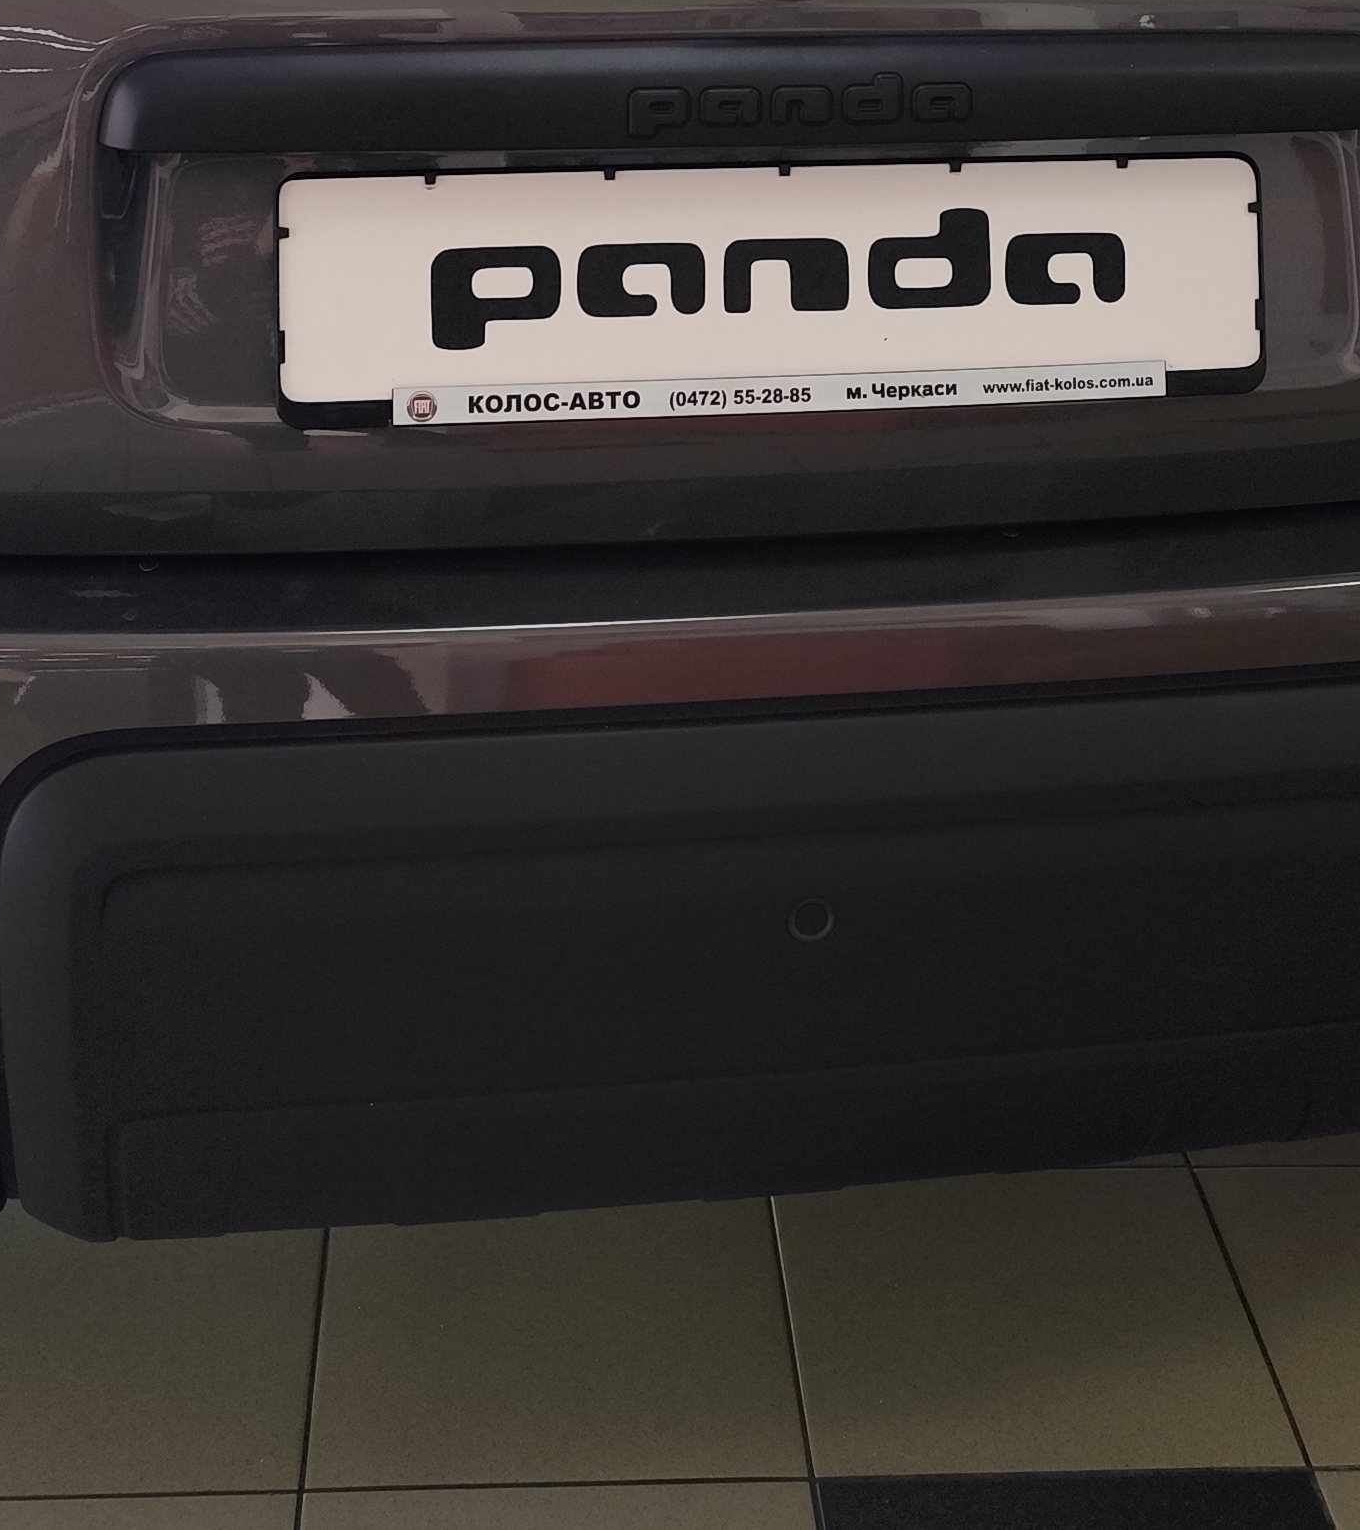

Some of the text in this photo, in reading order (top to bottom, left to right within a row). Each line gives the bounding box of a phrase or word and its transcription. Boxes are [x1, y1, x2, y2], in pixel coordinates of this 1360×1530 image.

[627, 71, 974, 140] panda
[430, 207, 1126, 351] panda
[467, 375, 1154, 414] КОЛОС-АВТО (0472) 55-28-85 м. Черкаси www.fiat-kolos.com.ua
